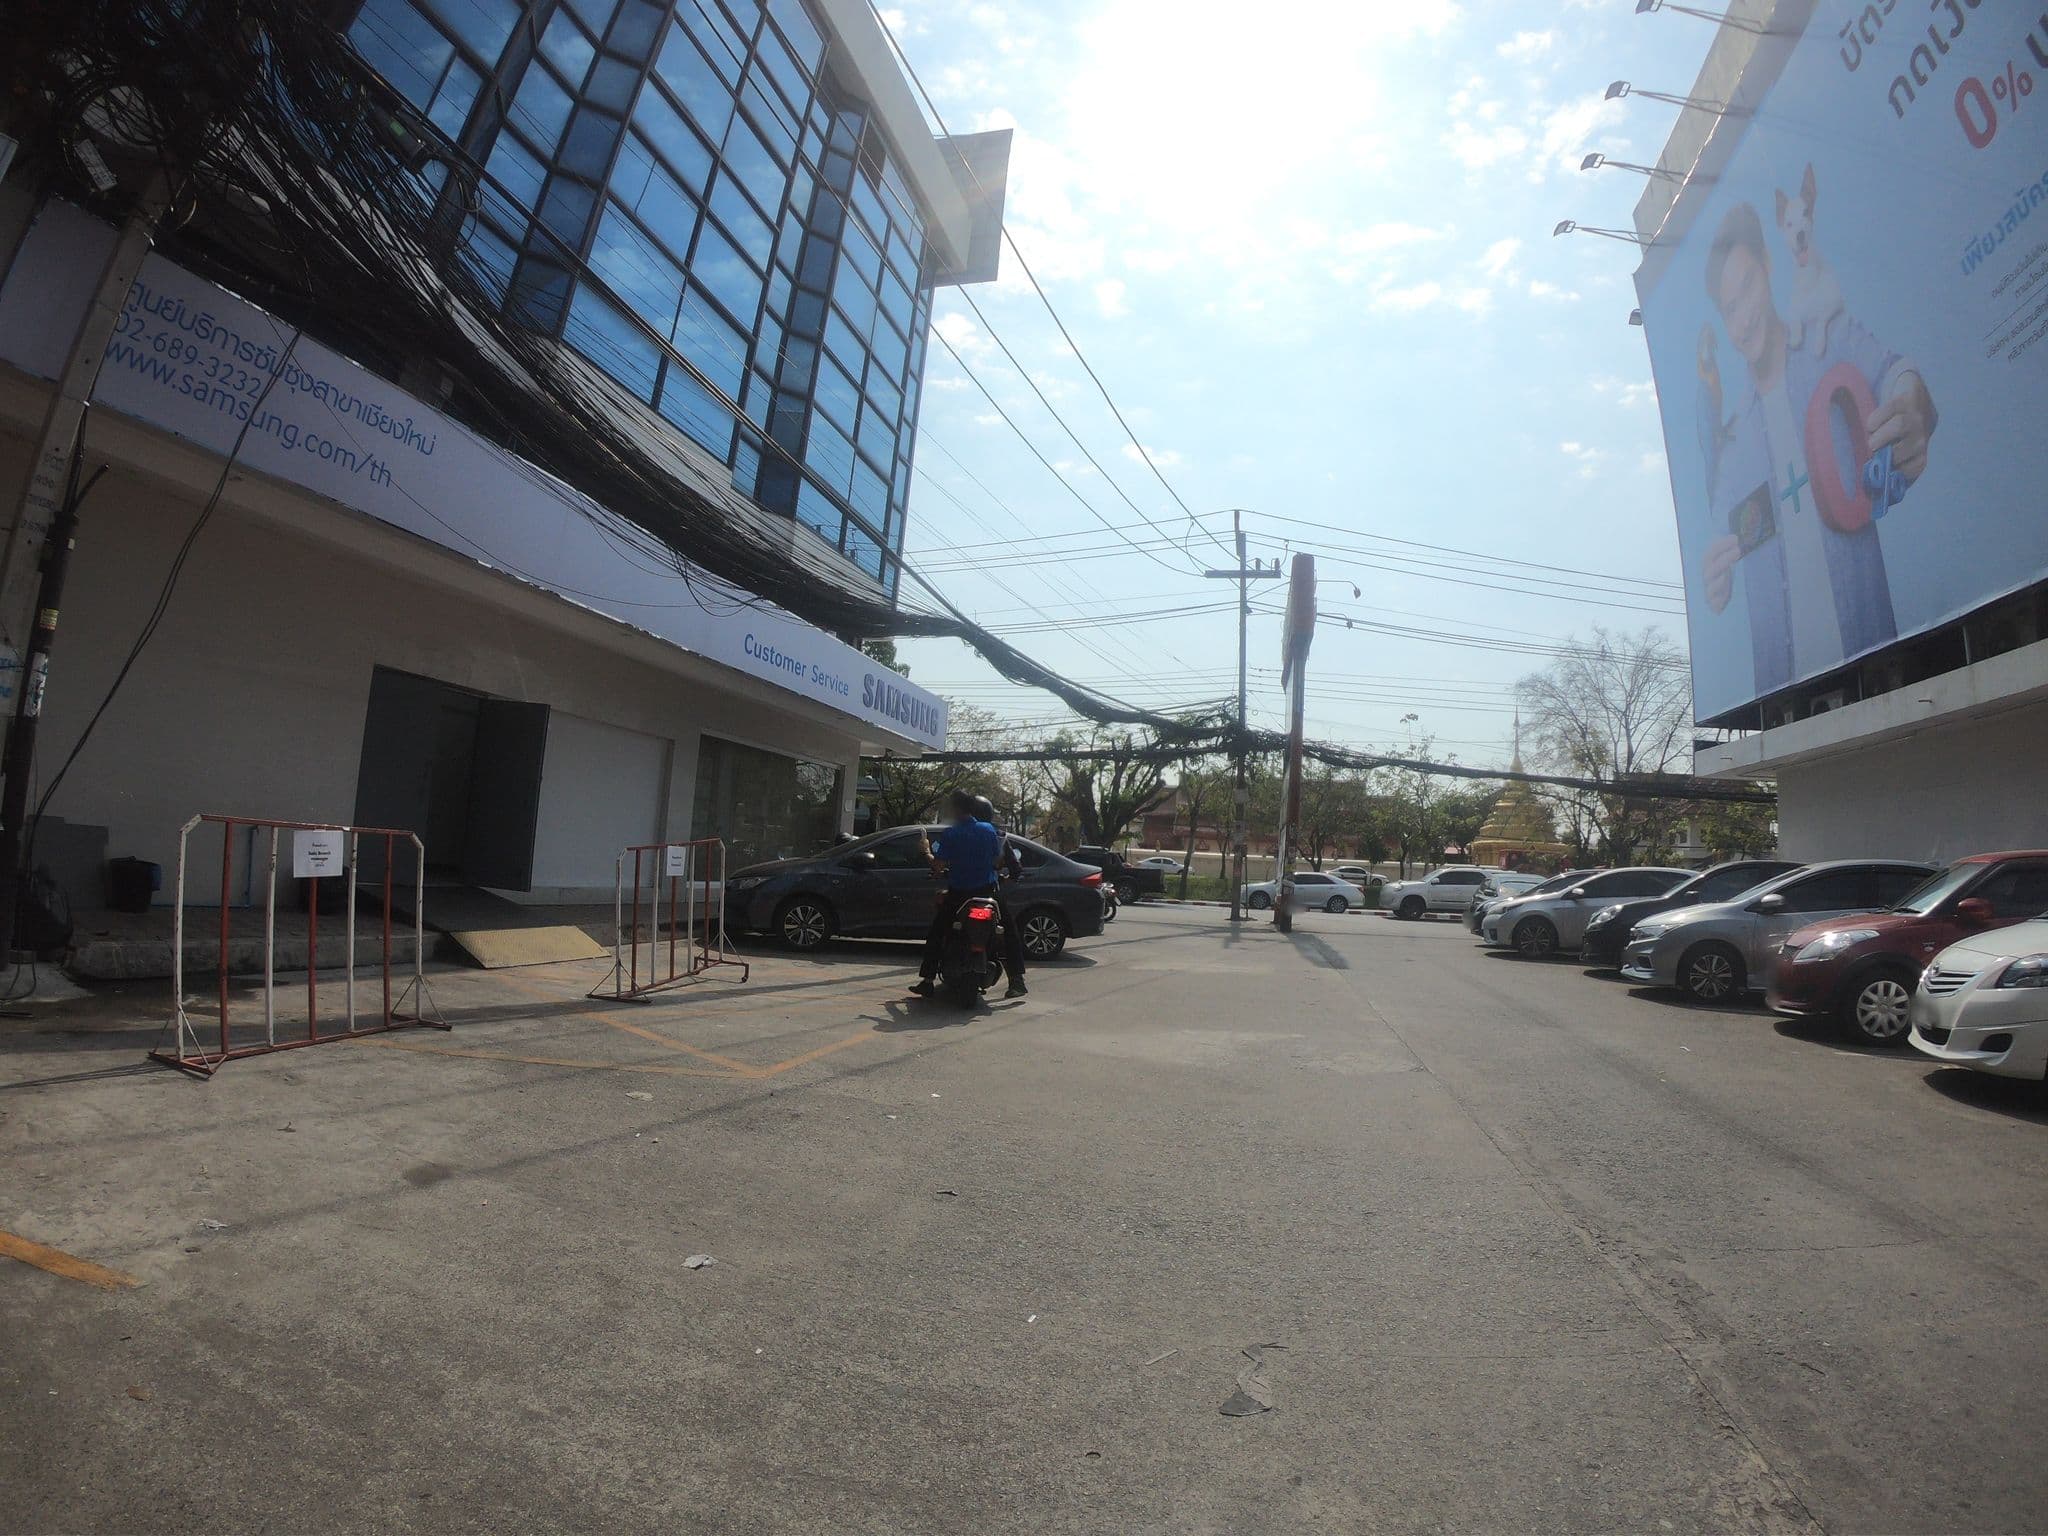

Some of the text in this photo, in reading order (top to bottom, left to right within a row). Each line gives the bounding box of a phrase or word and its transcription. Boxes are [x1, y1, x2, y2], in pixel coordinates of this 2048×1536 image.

[1954, 60, 2033, 149] 0%
[744, 633, 849, 697] Customer Service
[862, 673, 938, 736] SAMSUNG
